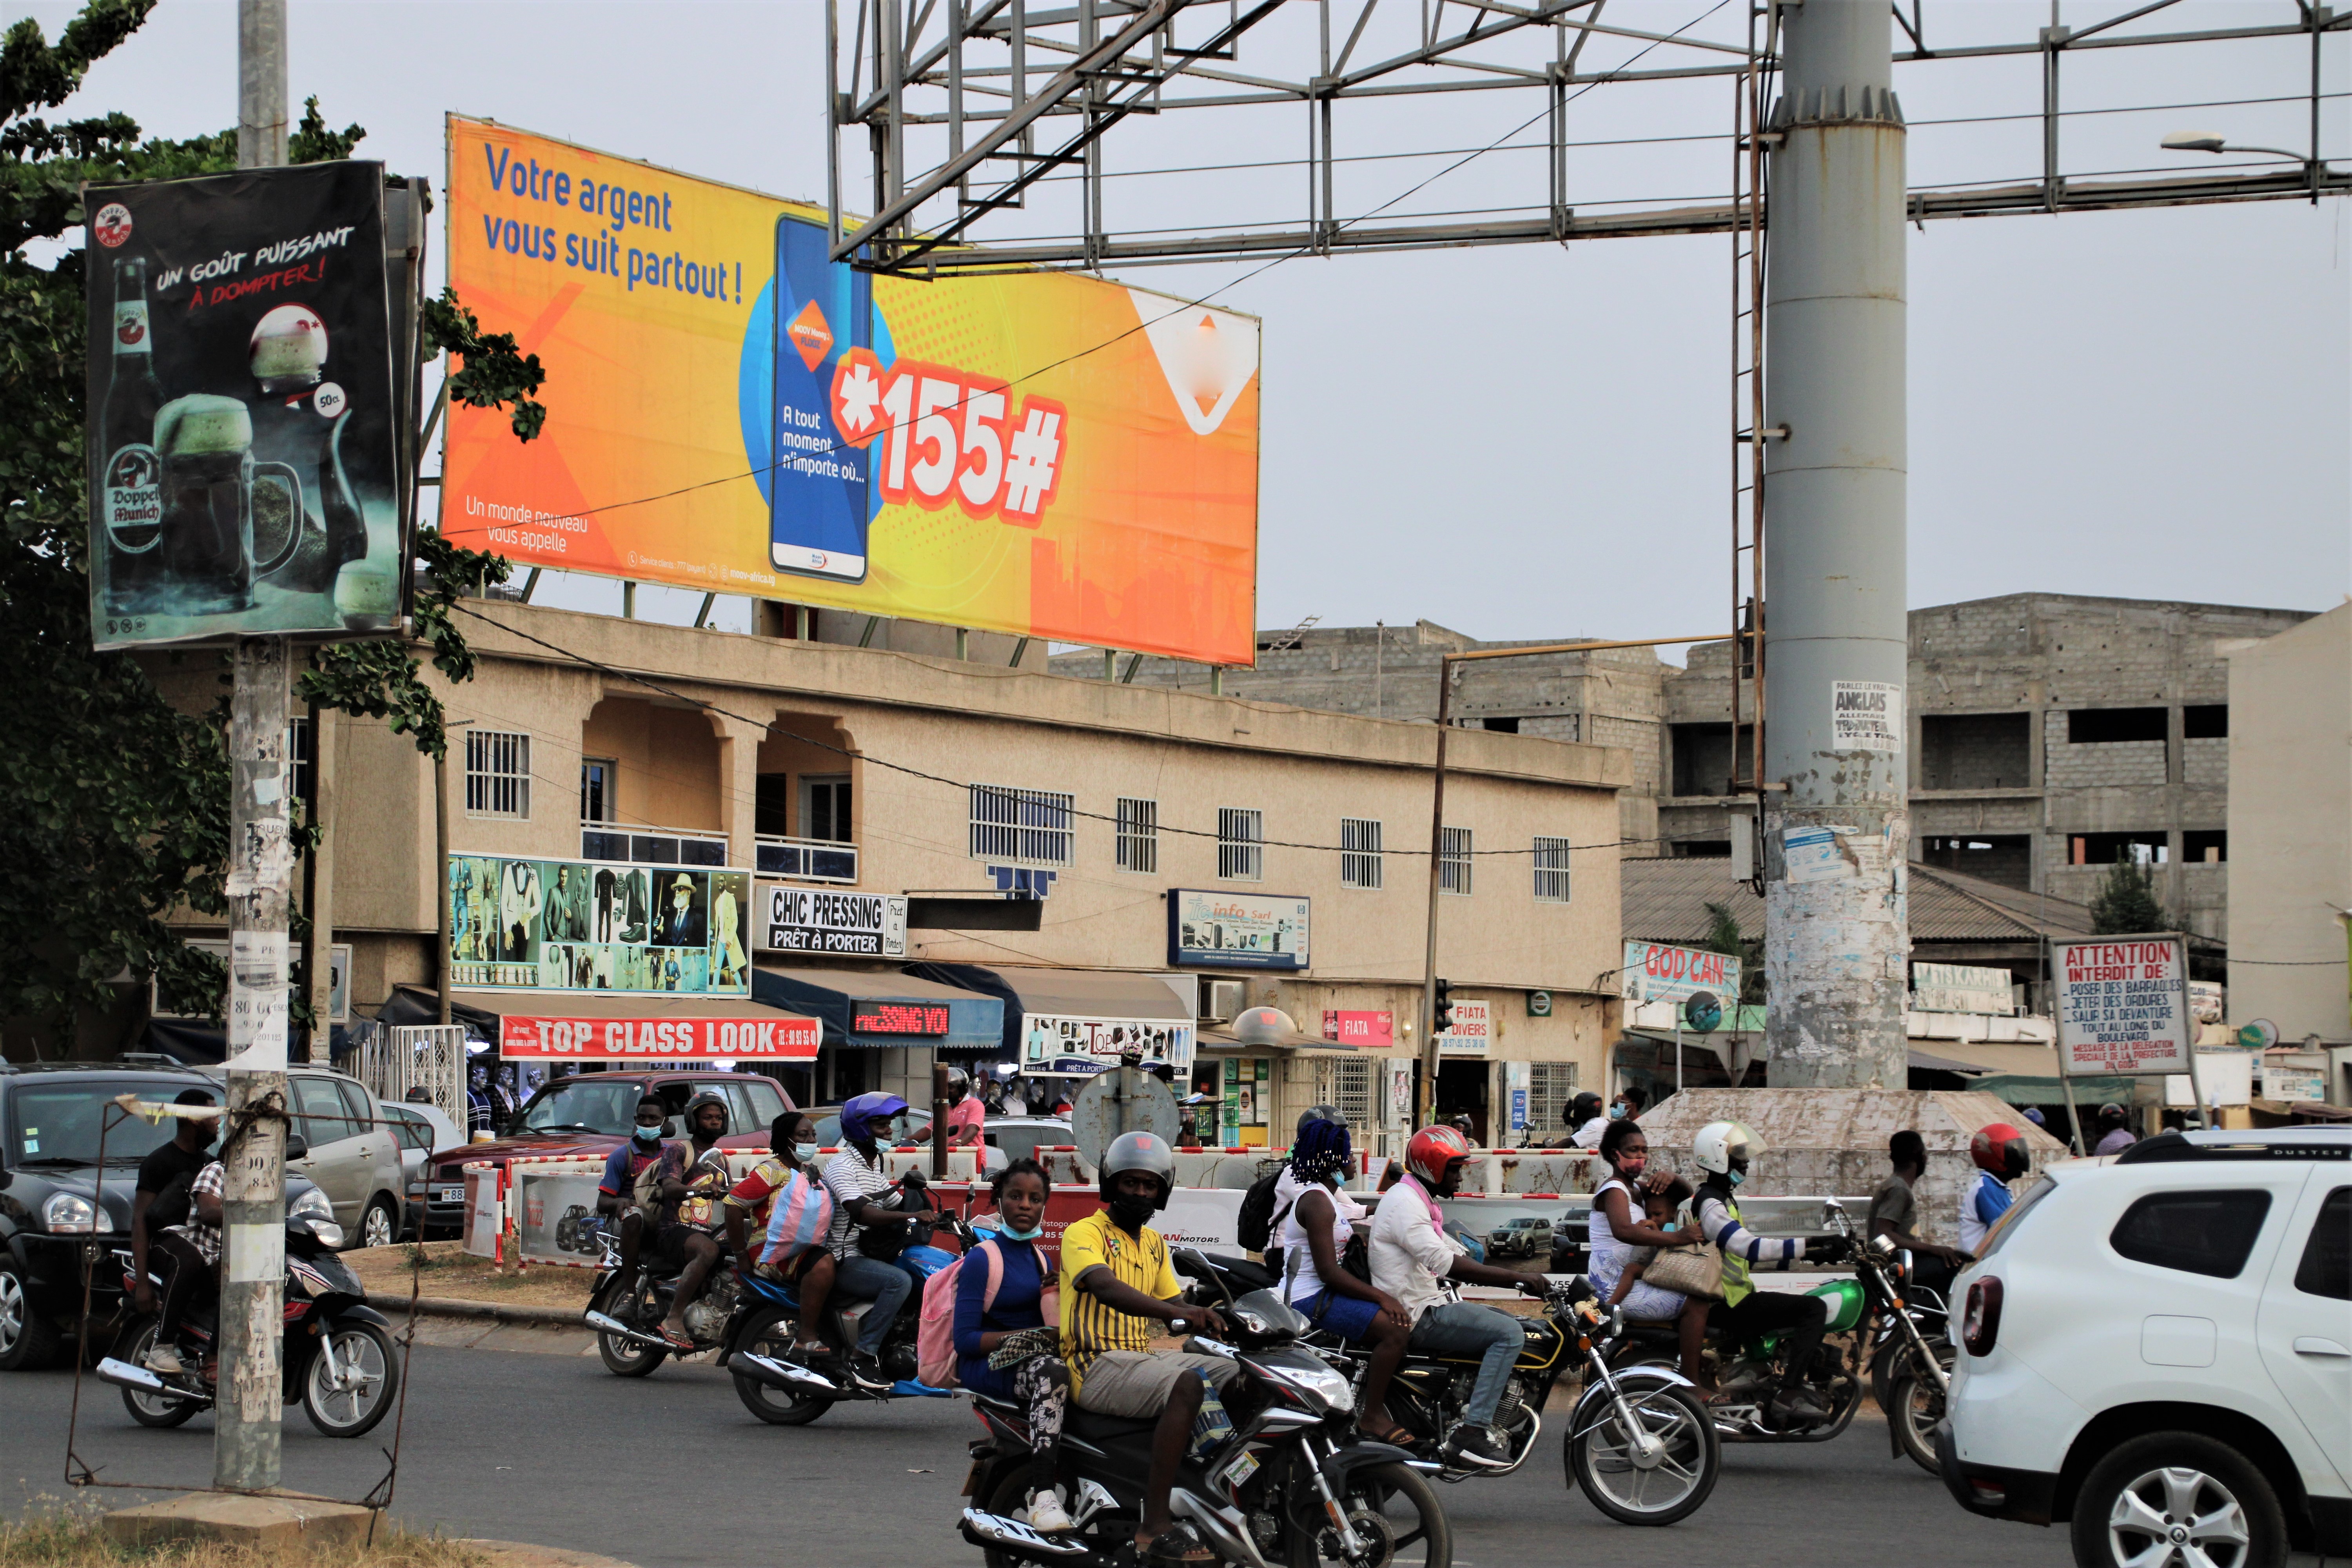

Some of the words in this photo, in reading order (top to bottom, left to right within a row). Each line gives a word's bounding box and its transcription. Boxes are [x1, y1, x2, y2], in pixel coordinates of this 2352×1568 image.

[485, 142, 570, 206] Votre
[579, 179, 671, 232] argent
[100, 207, 127, 220] Doppel
[158, 267, 183, 292] UN
[190, 250, 247, 282] GOÛT
[255, 227, 354, 266] PUISSANT
[484, 214, 556, 262] vous
[566, 229, 619, 277] suit
[628, 247, 727, 302] partout
[189, 285, 203, 310] À
[210, 264, 318, 305] DOMPTER
[794, 324, 811, 334] MOOV
[811, 327, 827, 341] Money
[801, 337, 821, 349] FLOOZ
[783, 405, 792, 425] A
[795, 408, 820, 430] tout
[783, 431, 835, 457] moment,
[783, 452, 838, 480] n'importe
[841, 461, 865, 483] où...
[113, 486, 158, 506] Doppel
[114, 503, 159, 522] Munich
[466, 495, 485, 517] Un
[488, 503, 532, 523] monde
[535, 511, 588, 533] nouveau
[487, 526, 517, 544] vous
[521, 530, 566, 553] appelle
[640, 555, 658, 567] Service
[659, 557, 674, 569] clients
[677, 559, 686, 570] 777
[687, 561, 706, 575] (payant)
[730, 570, 775, 587] moov-africa.tg
[1836, 691, 1887, 712] ANGLAIS
[773, 891, 807, 924] CHIC
[813, 894, 882, 929] PRESSING
[890, 905, 903, 916] Prêt
[1213, 903, 1246, 918] info
[1251, 910, 1272, 919] Sarl
[893, 921, 898, 931] à
[774, 927, 810, 949] PRÊT
[812, 928, 822, 949] À
[826, 933, 877, 953] PORTER
[886, 937, 902, 949] Porter
[2065, 942, 2172, 967] ATTENTION
[1646, 945, 1686, 979] GOD
[1690, 952, 1725, 985] CAN
[2068, 965, 2136, 982] INTERDIT
[2071, 983, 2102, 996] POSER
[2105, 982, 2122, 995] DES
[2072, 996, 2100, 1009] JETER
[2103, 995, 2122, 1008] DES
[2125, 994, 2168, 1006] ORDURES
[1456, 1006, 1486, 1019] FIATA
[2072, 1010, 2100, 1022] SALIR
[2103, 1009, 2115, 1021] SA
[2119, 1006, 2173, 1020] DEVANTURE
[1345, 1020, 1368, 1035] FIATA
[1452, 1024, 1487, 1036] DIVERS
[2082, 1023, 2106, 1033] TOUT
[2109, 1023, 2122, 1032] AU
[2125, 1021, 2149, 1032] LONG
[2152, 1020, 2165, 1030] DU
[535, 1021, 592, 1052] TOP
[605, 1022, 693, 1053] CLASS
[706, 1022, 776, 1053] LOOK
[789, 1031, 795, 1046] 90
[796, 1031, 802, 1046] 93
[803, 1031, 809, 1046] 55
[809, 1032, 816, 1046] 40
[1084, 1022, 1112, 1054] TOP
[1465, 1039, 1470, 1048] 25
[1472, 1039, 1478, 1047] 38
[1479, 1039, 1485, 1047] 06
[2097, 1031, 2149, 1043] BOULEVARD
[2073, 1042, 2107, 1053] MESSAGE
[2109, 1042, 2117, 1051] DE
[2120, 1042, 2129, 1051] LA
[2132, 1040, 2175, 1050] DELEGATION
[2073, 1053, 2107, 1062] SPECIALE
[2110, 1052, 2119, 1061] DE
[2122, 1051, 2131, 1060] LA
[2133, 1049, 2178, 1060] PREFECTURE
[1067, 1063, 1081, 1072] PRÊT
[2104, 1061, 2115, 1070] DU
[2118, 1060, 2140, 1069] GOLFE
[451, 1189, 465, 1200] 88
[290, 1296, 314, 1305] Haojue
[1285, 1403, 1312, 1414] Haojue
